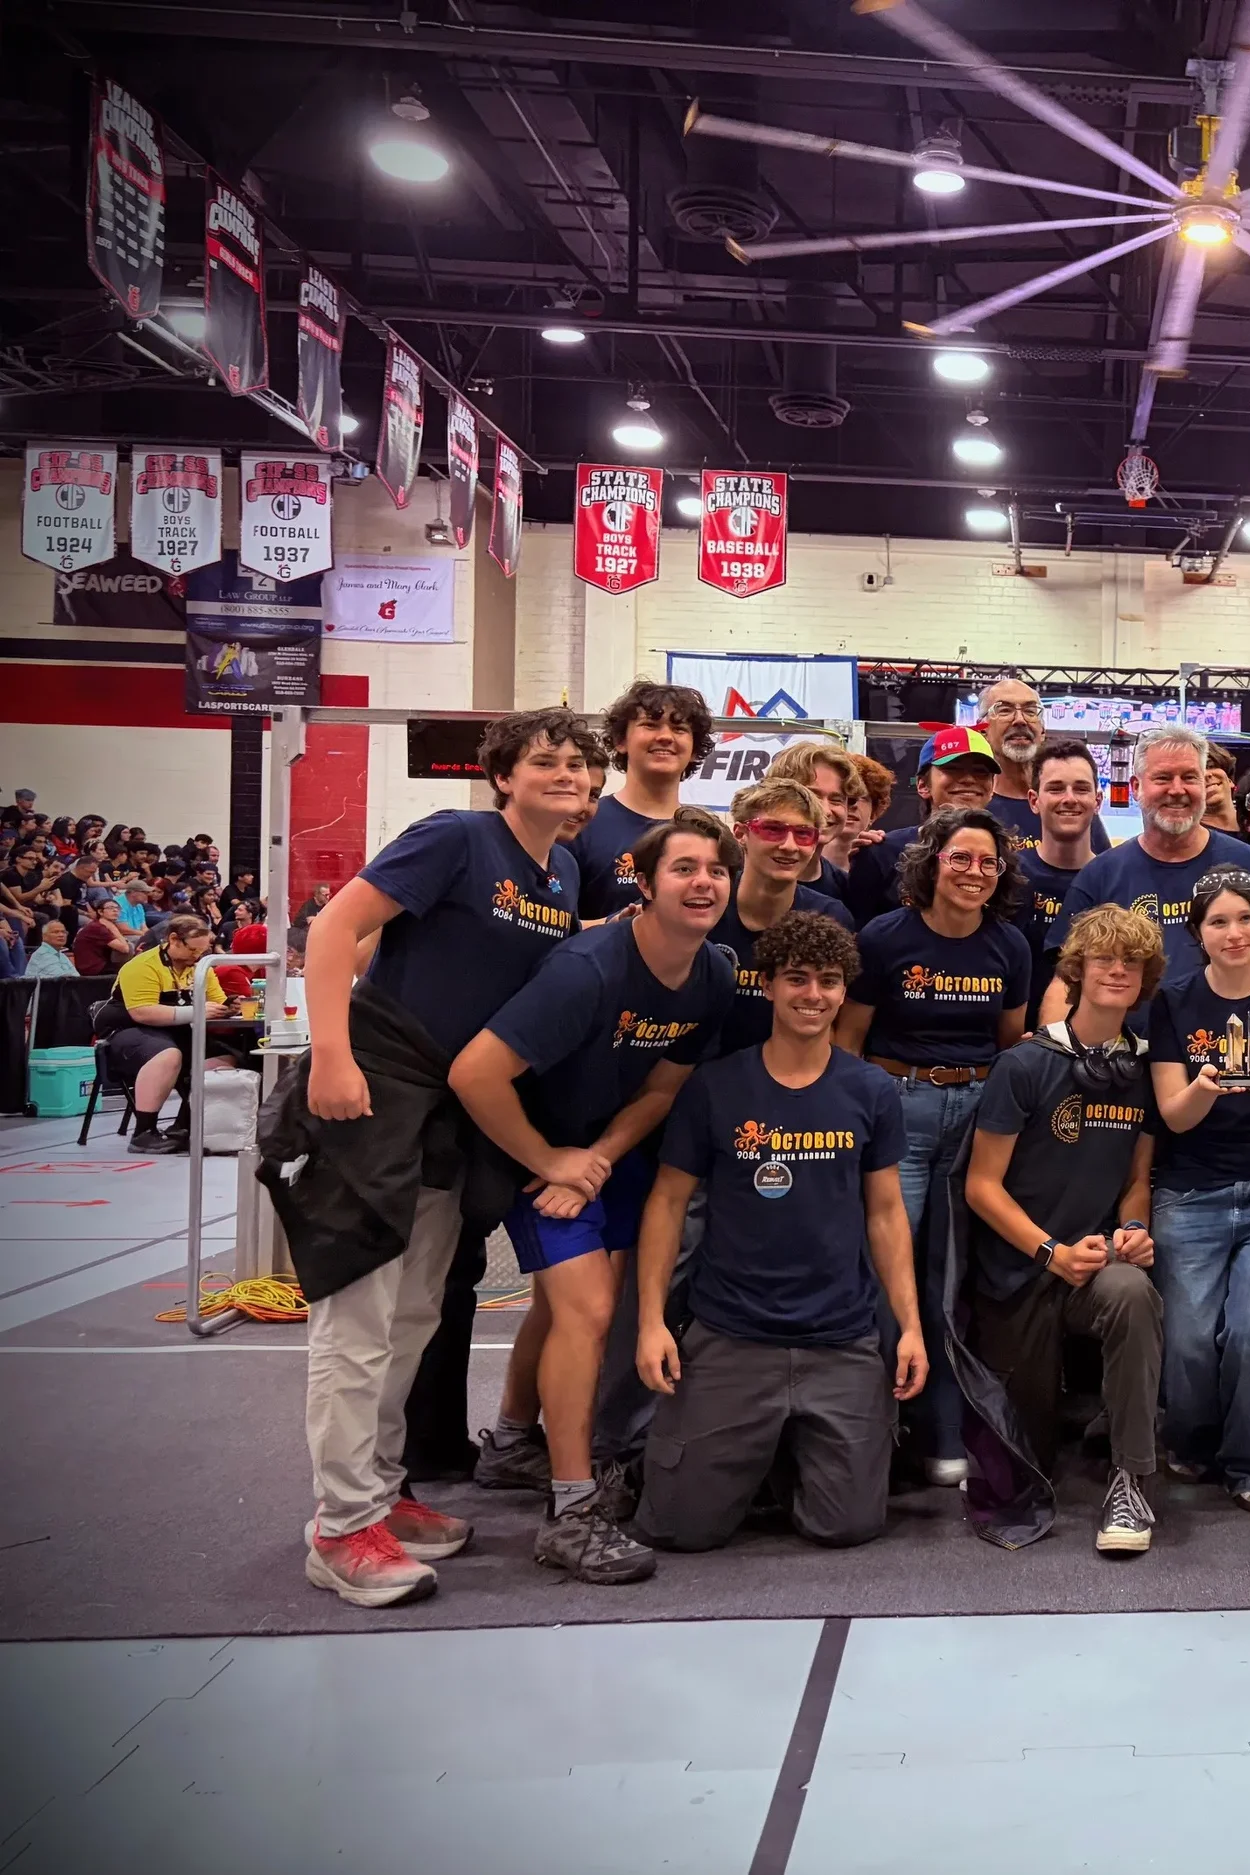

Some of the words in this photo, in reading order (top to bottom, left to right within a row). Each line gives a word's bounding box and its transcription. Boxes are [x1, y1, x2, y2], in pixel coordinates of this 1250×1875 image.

[591, 471, 648, 488] STATE
[715, 477, 772, 494] STATE
[582, 485, 655, 511] CHAMPIONS
[707, 491, 780, 515] CHAMPIONS
[36, 515, 102, 530] FOOTBALL
[163, 515, 191, 525] BOYS
[158, 527, 196, 538] TRACK
[253, 526, 320, 539] FOOTBALL
[603, 533, 632, 545] BOYS
[46, 536, 92, 553] 1924
[157, 540, 199, 556] 1927
[596, 544, 637, 558] TRACK
[707, 540, 779, 556] BASEBALL
[263, 546, 310, 563] 1937
[595, 556, 637, 575] 1927
[720, 561, 766, 578] 1938
[56, 572, 163, 594] SEAWEED
[336, 577, 364, 591] James
[366, 580, 383, 589] and
[385, 578, 411, 594] Mary
[414, 579, 438, 592] Clark
[244, 591, 277, 601] GROUP
[220, 604, 245, 614] (800)
[940, 742, 960, 750] 687
[700, 750, 781, 780] FIR
[616, 876, 638, 885] 9084
[492, 907, 513, 922] 9084
[519, 899, 572, 931] OCTOBOT
[517, 918, 535, 931] SANTA
[537, 925, 564, 938] BARBARA
[935, 975, 1003, 993] OCTOBOTS
[903, 991, 926, 999] 9084
[934, 993, 957, 1001] SANTA
[959, 994, 990, 1002] BARBARA
[1189, 1054, 1210, 1063] 9084
[1086, 1103, 1145, 1123] OCTOBOTS
[1084, 1120, 1104, 1128] SANTA
[771, 1131, 855, 1151] OCTOBOTS
[736, 1150, 761, 1160] 9084
[771, 1153, 796, 1161] SANTA
[798, 1152, 836, 1160] BARBARA
